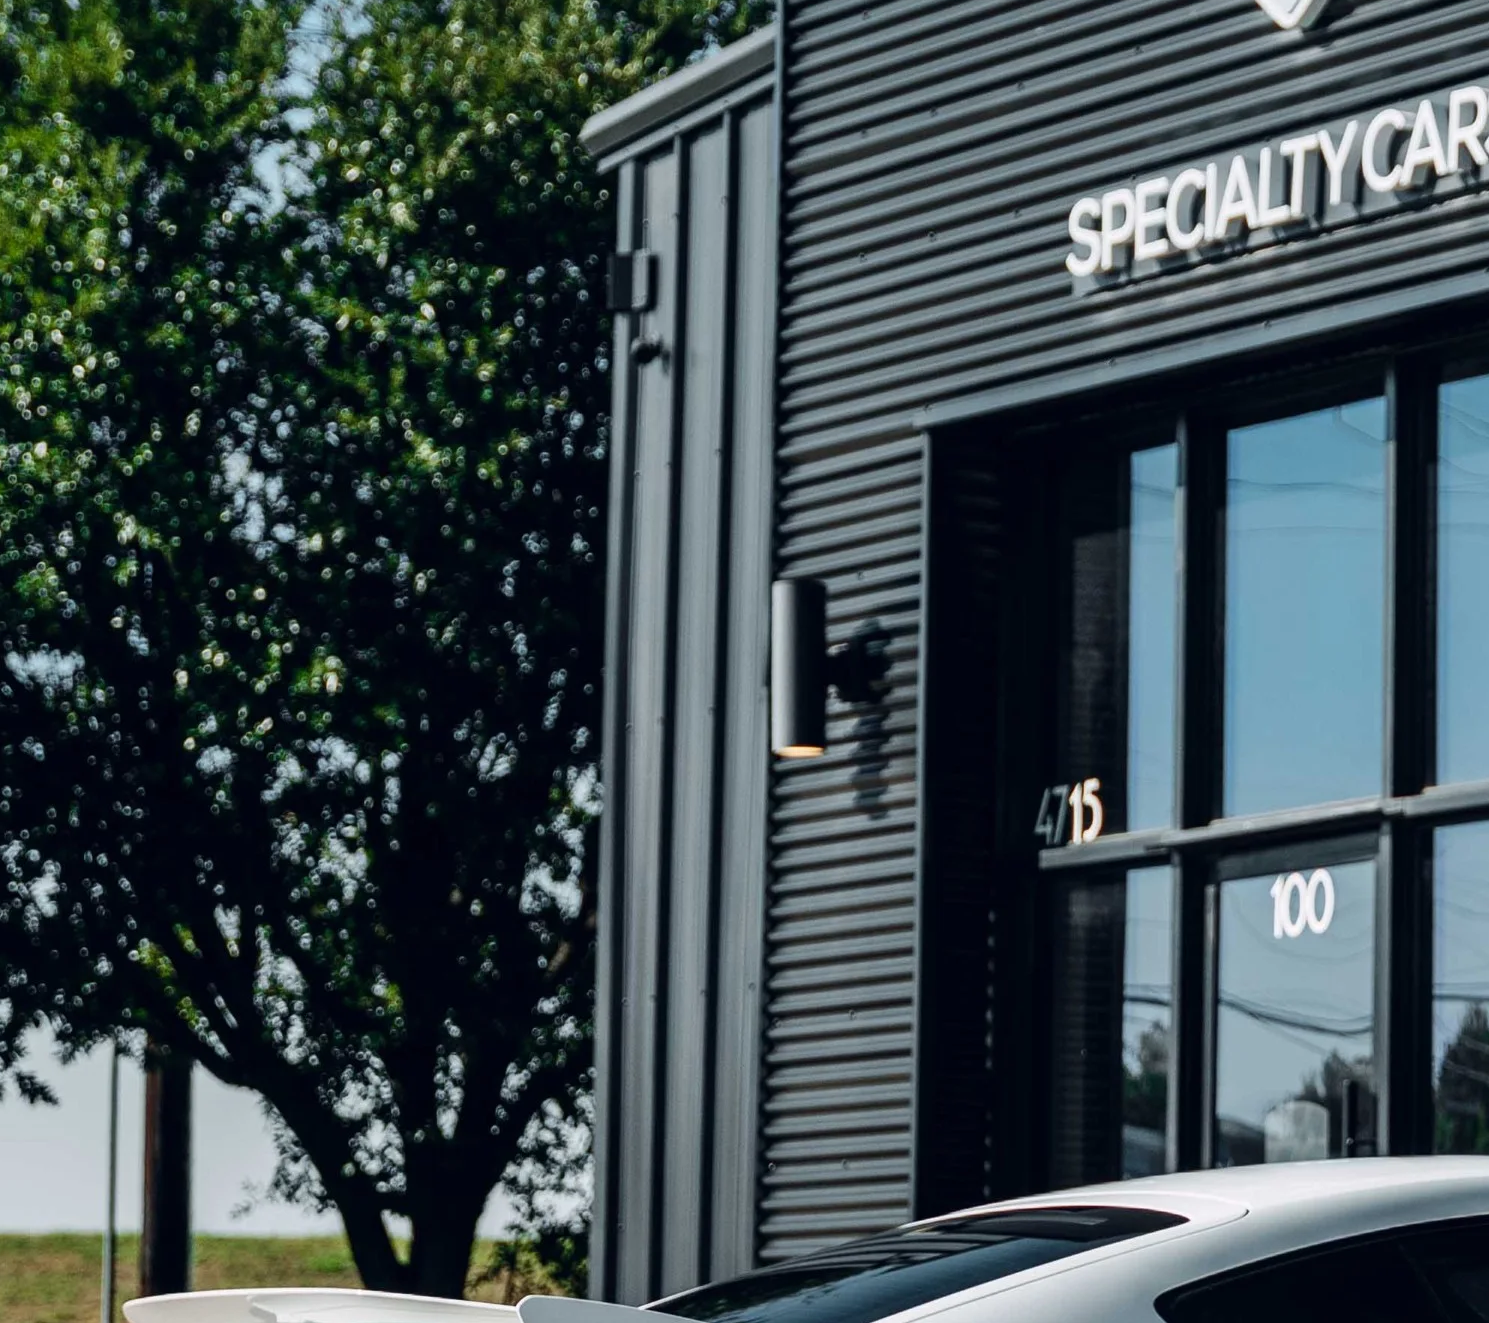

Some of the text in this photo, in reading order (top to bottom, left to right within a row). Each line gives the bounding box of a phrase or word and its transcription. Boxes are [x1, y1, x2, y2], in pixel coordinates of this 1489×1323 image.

[1066, 119, 1359, 277] SPECIALTY
[1033, 777, 1104, 846] 4715
[1270, 867, 1336, 940] 100
